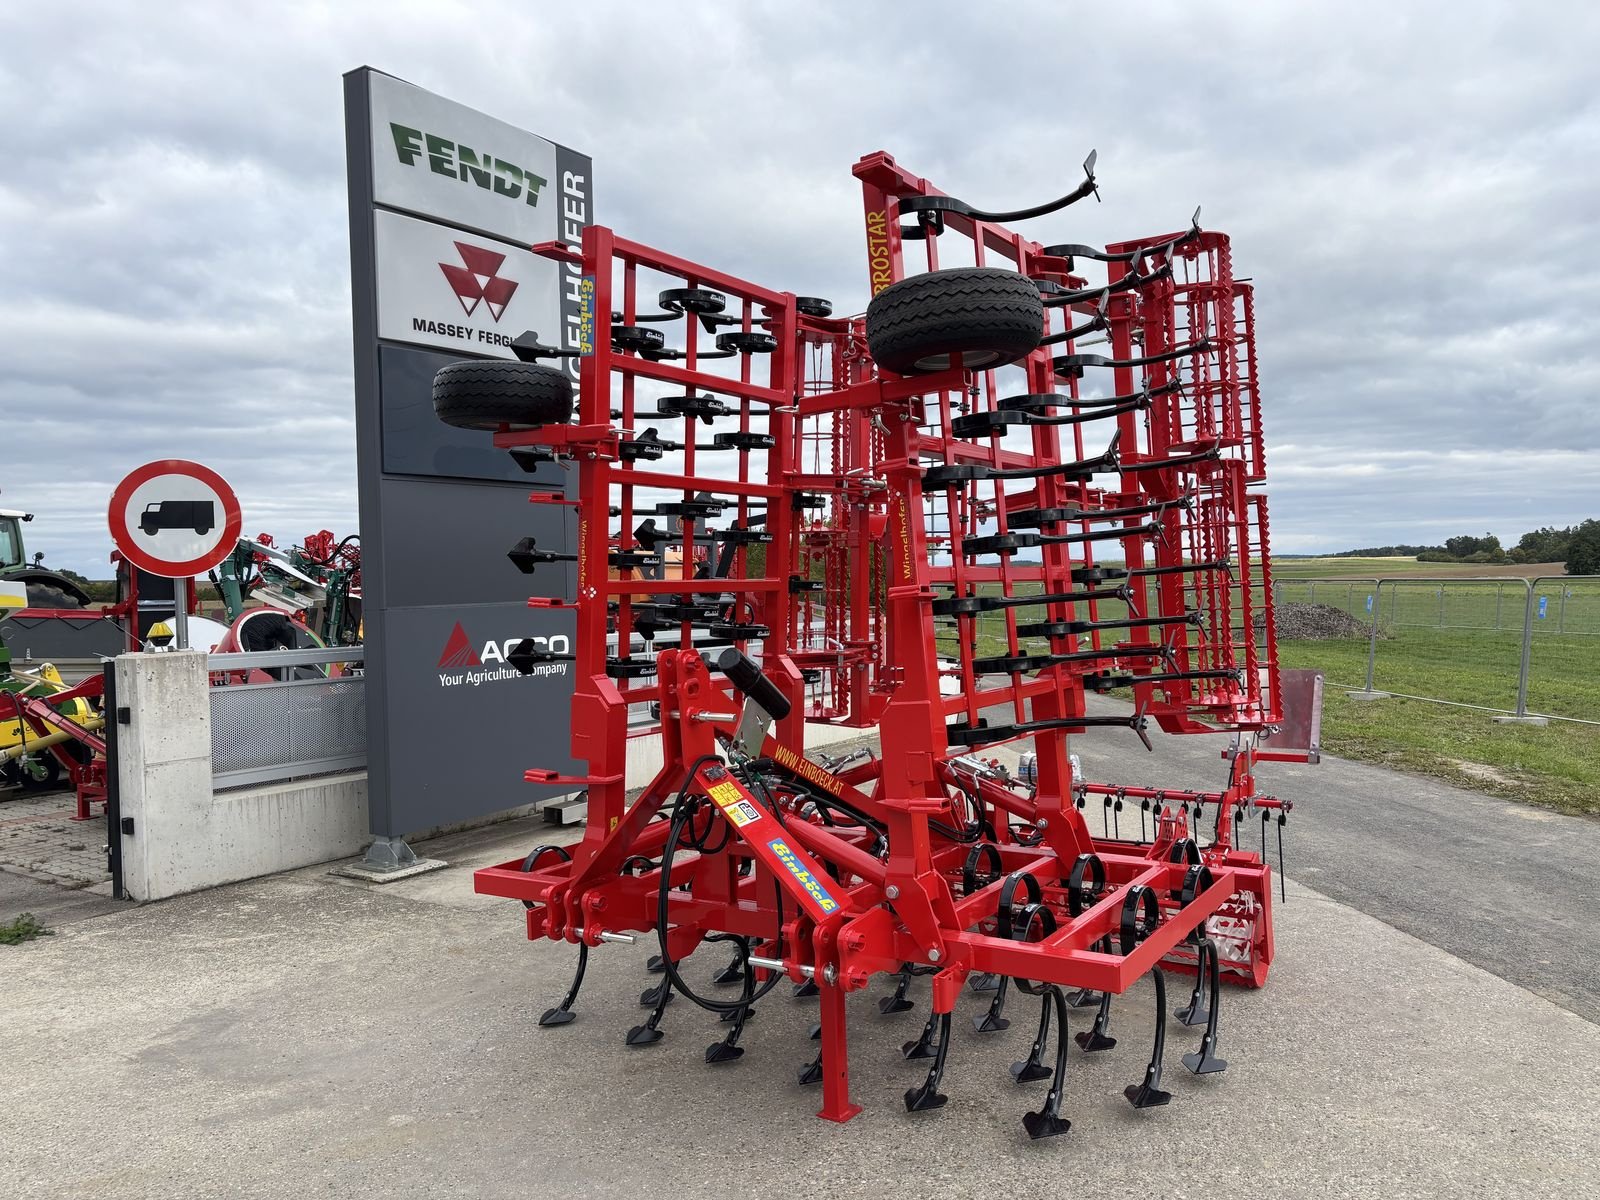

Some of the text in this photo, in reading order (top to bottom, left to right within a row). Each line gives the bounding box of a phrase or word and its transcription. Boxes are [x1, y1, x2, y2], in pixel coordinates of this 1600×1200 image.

[390, 122, 547, 207] FENDT
[867, 210, 892, 297] BROSTAR
[412, 317, 514, 348] MASSEY FERG
[439, 663, 567, 687] Your Agriculture ompany
[774, 744, 844, 796] WWW.EINBOECK.AT
[772, 842, 836, 911] Einböck
